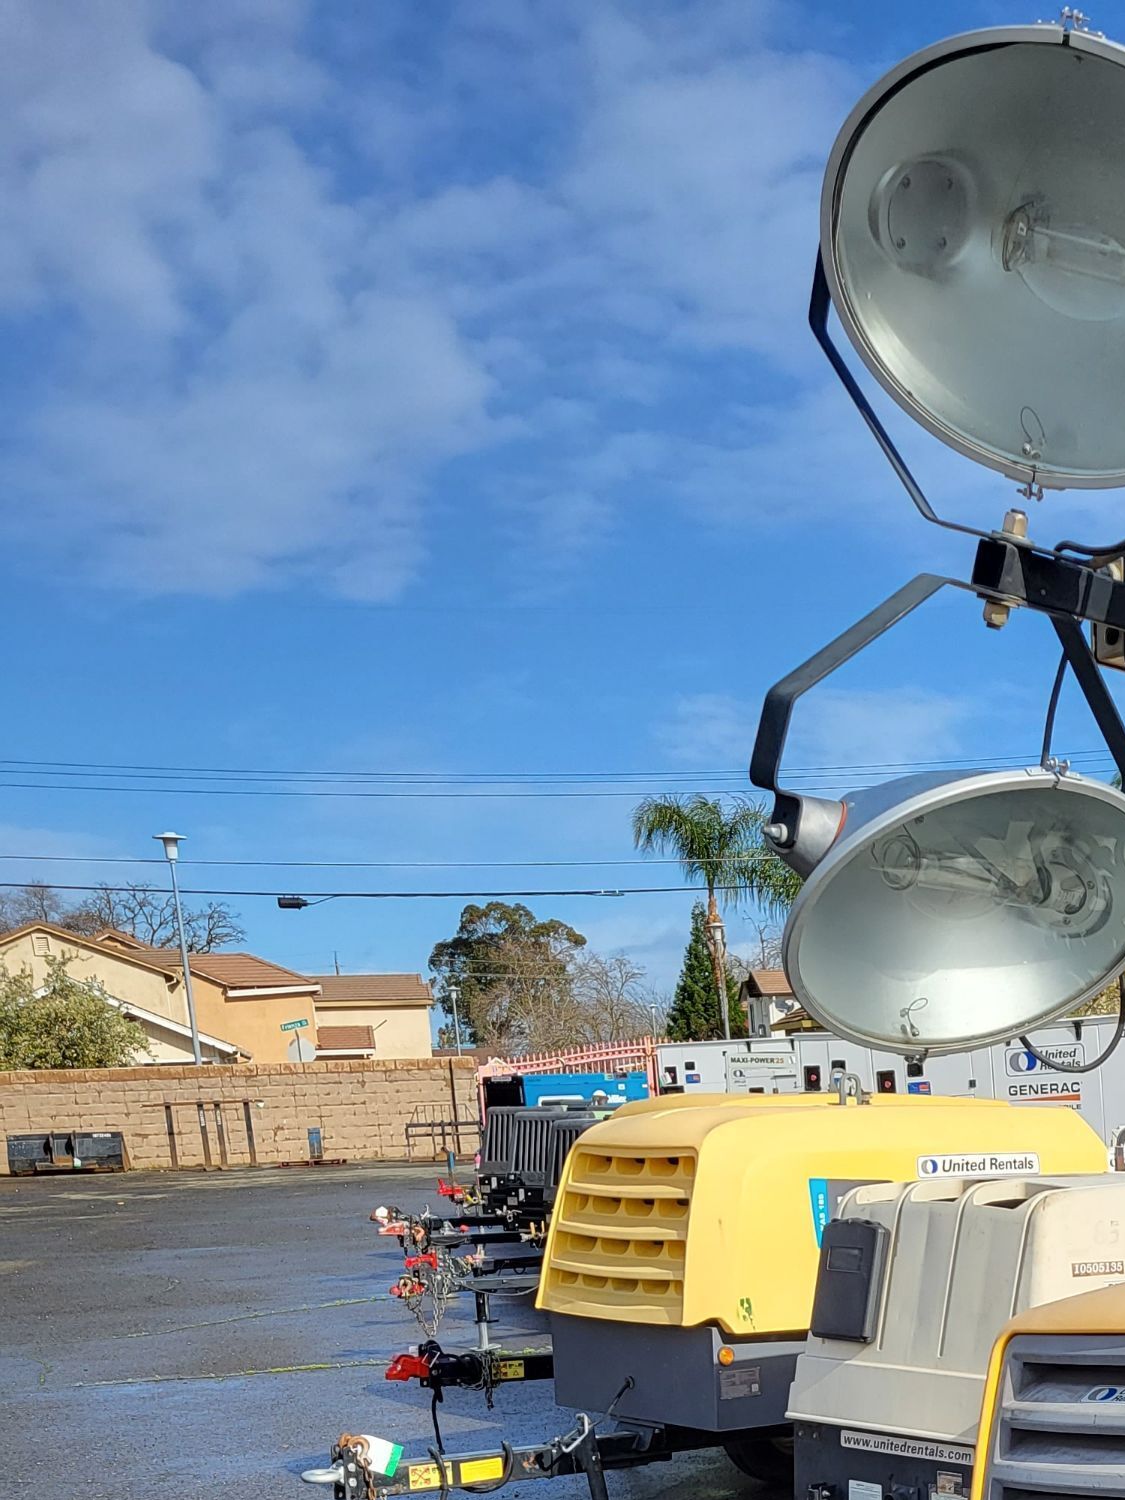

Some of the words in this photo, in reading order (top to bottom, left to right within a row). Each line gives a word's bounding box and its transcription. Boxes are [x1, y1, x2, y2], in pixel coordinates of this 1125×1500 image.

[1008, 1081, 1080, 1096] GENERAC
[942, 1158, 986, 1173] United
[989, 1156, 1034, 1171] Rentals
[843, 1434, 972, 1462] www.unitedrentals.com
